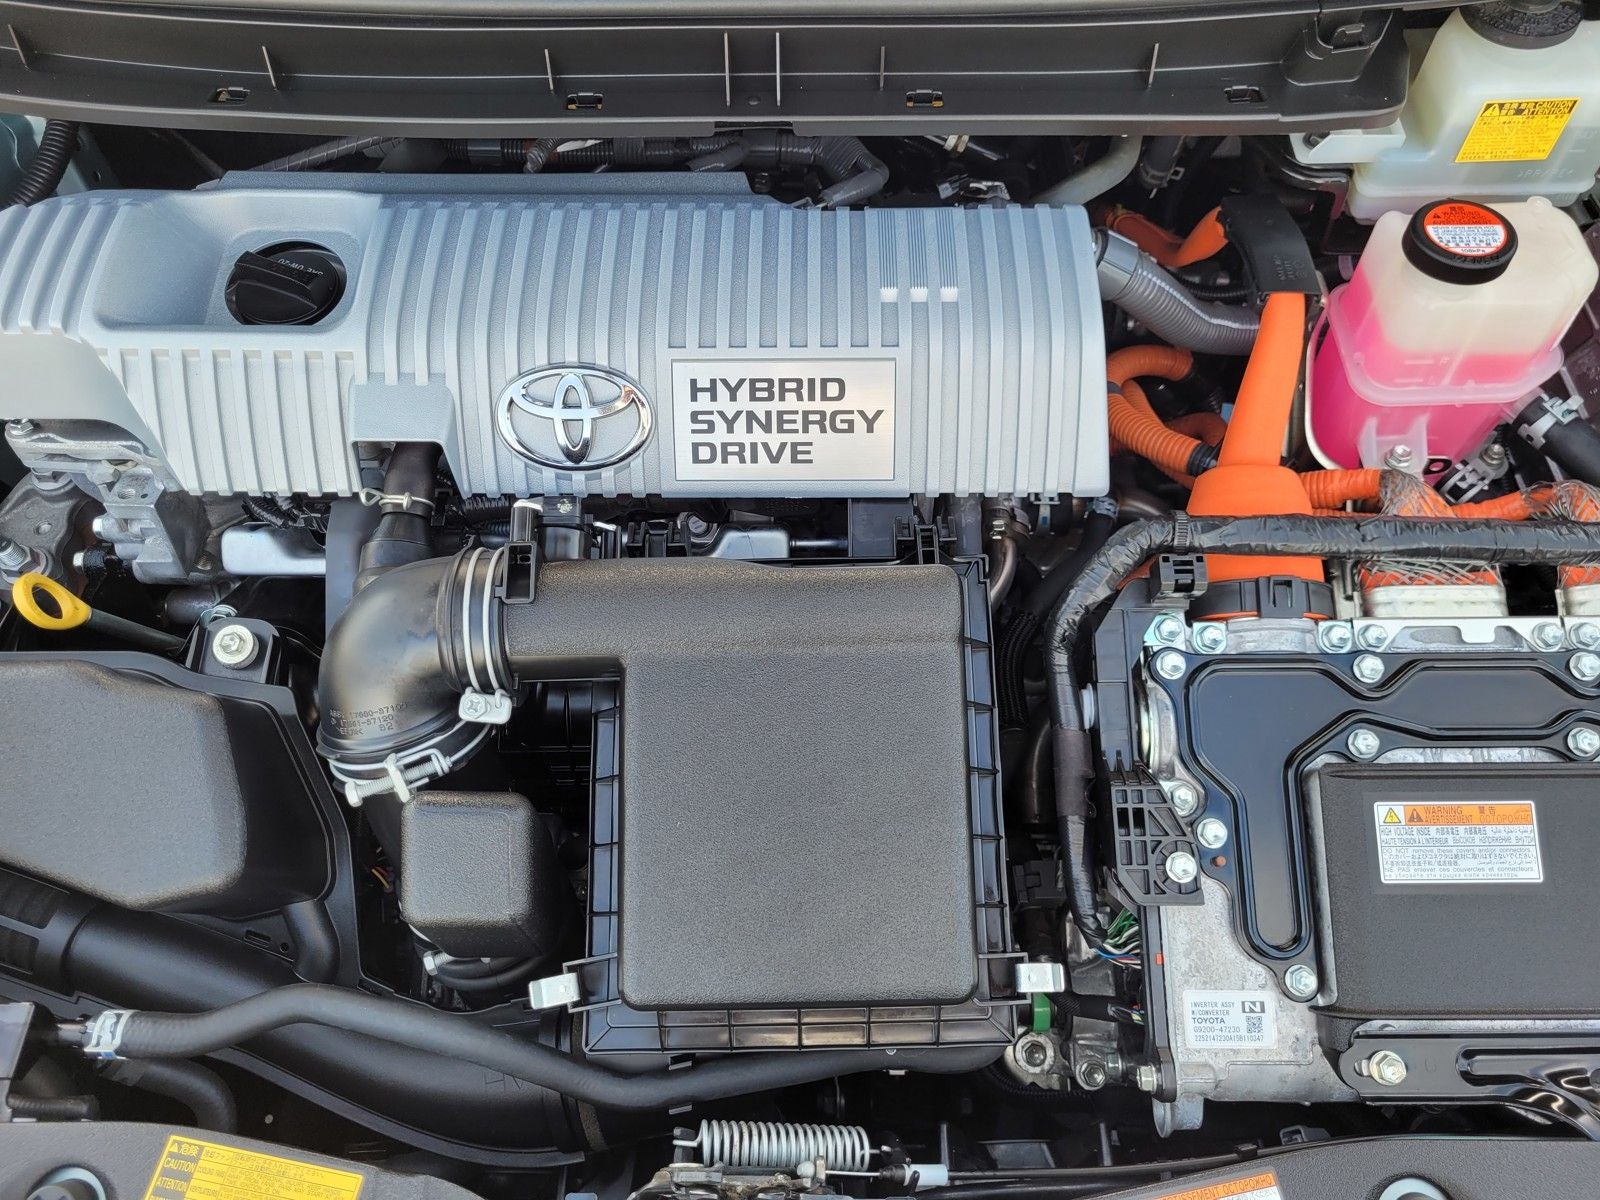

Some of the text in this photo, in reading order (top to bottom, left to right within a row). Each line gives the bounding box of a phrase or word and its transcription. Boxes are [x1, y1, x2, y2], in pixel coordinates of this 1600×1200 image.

[1537, 100, 1572, 108] CAUTION
[1522, 108, 1569, 116] ATTENTION
[690, 378, 846, 402] HYBRID
[690, 410, 885, 434] SYNERGY
[691, 442, 814, 464] DRIVE
[1424, 806, 1463, 815] WARNING
[1424, 815, 1473, 824] AVERTISSEMENT
[1394, 827, 1414, 836] VOLTAGE
[1416, 827, 1432, 836] INSIDE
[163, 1158, 198, 1173] CAUTION
[155, 1176, 188, 1192] ATTENTION
